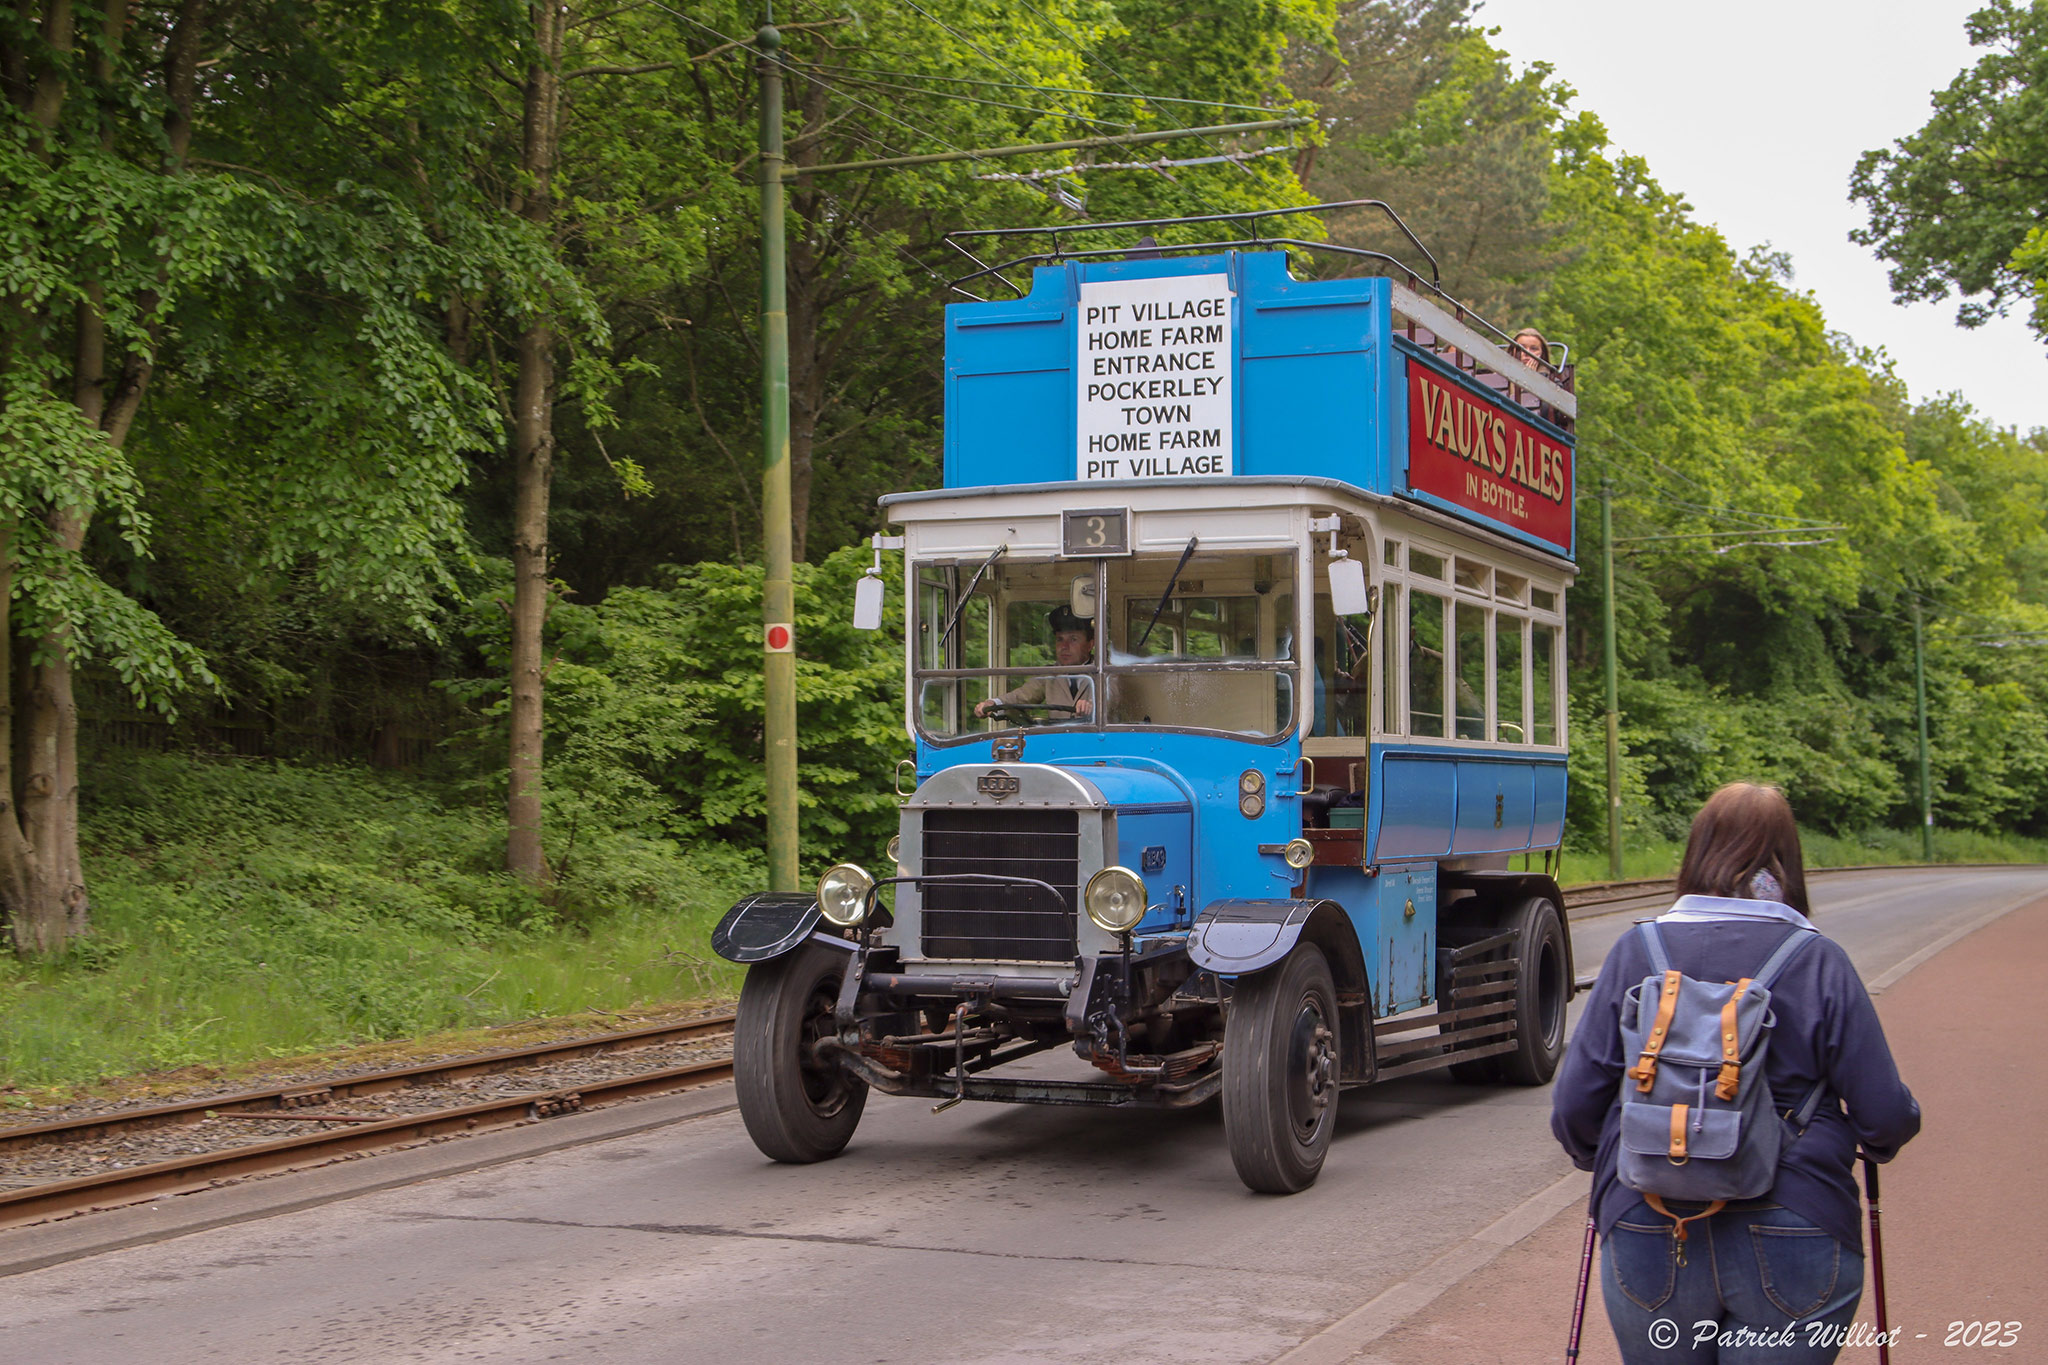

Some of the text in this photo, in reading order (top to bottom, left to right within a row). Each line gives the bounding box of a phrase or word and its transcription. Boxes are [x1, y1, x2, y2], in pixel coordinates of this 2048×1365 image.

[1087, 298, 1226, 325] PIT VILLAGE
[1088, 324, 1223, 351] HOME FARM
[1093, 351, 1215, 376] ENTRANCE
[1087, 376, 1224, 402] POCKERLEY
[1121, 404, 1191, 426] TOWN
[1088, 428, 1221, 453] HOME FARM
[1419, 376, 1565, 505] VAUX'S ALES
[1087, 455, 1224, 479] PIT VILLAGE
[1466, 472, 1529, 520] IN BOTTLE.
[1086, 516, 1106, 547] 3
